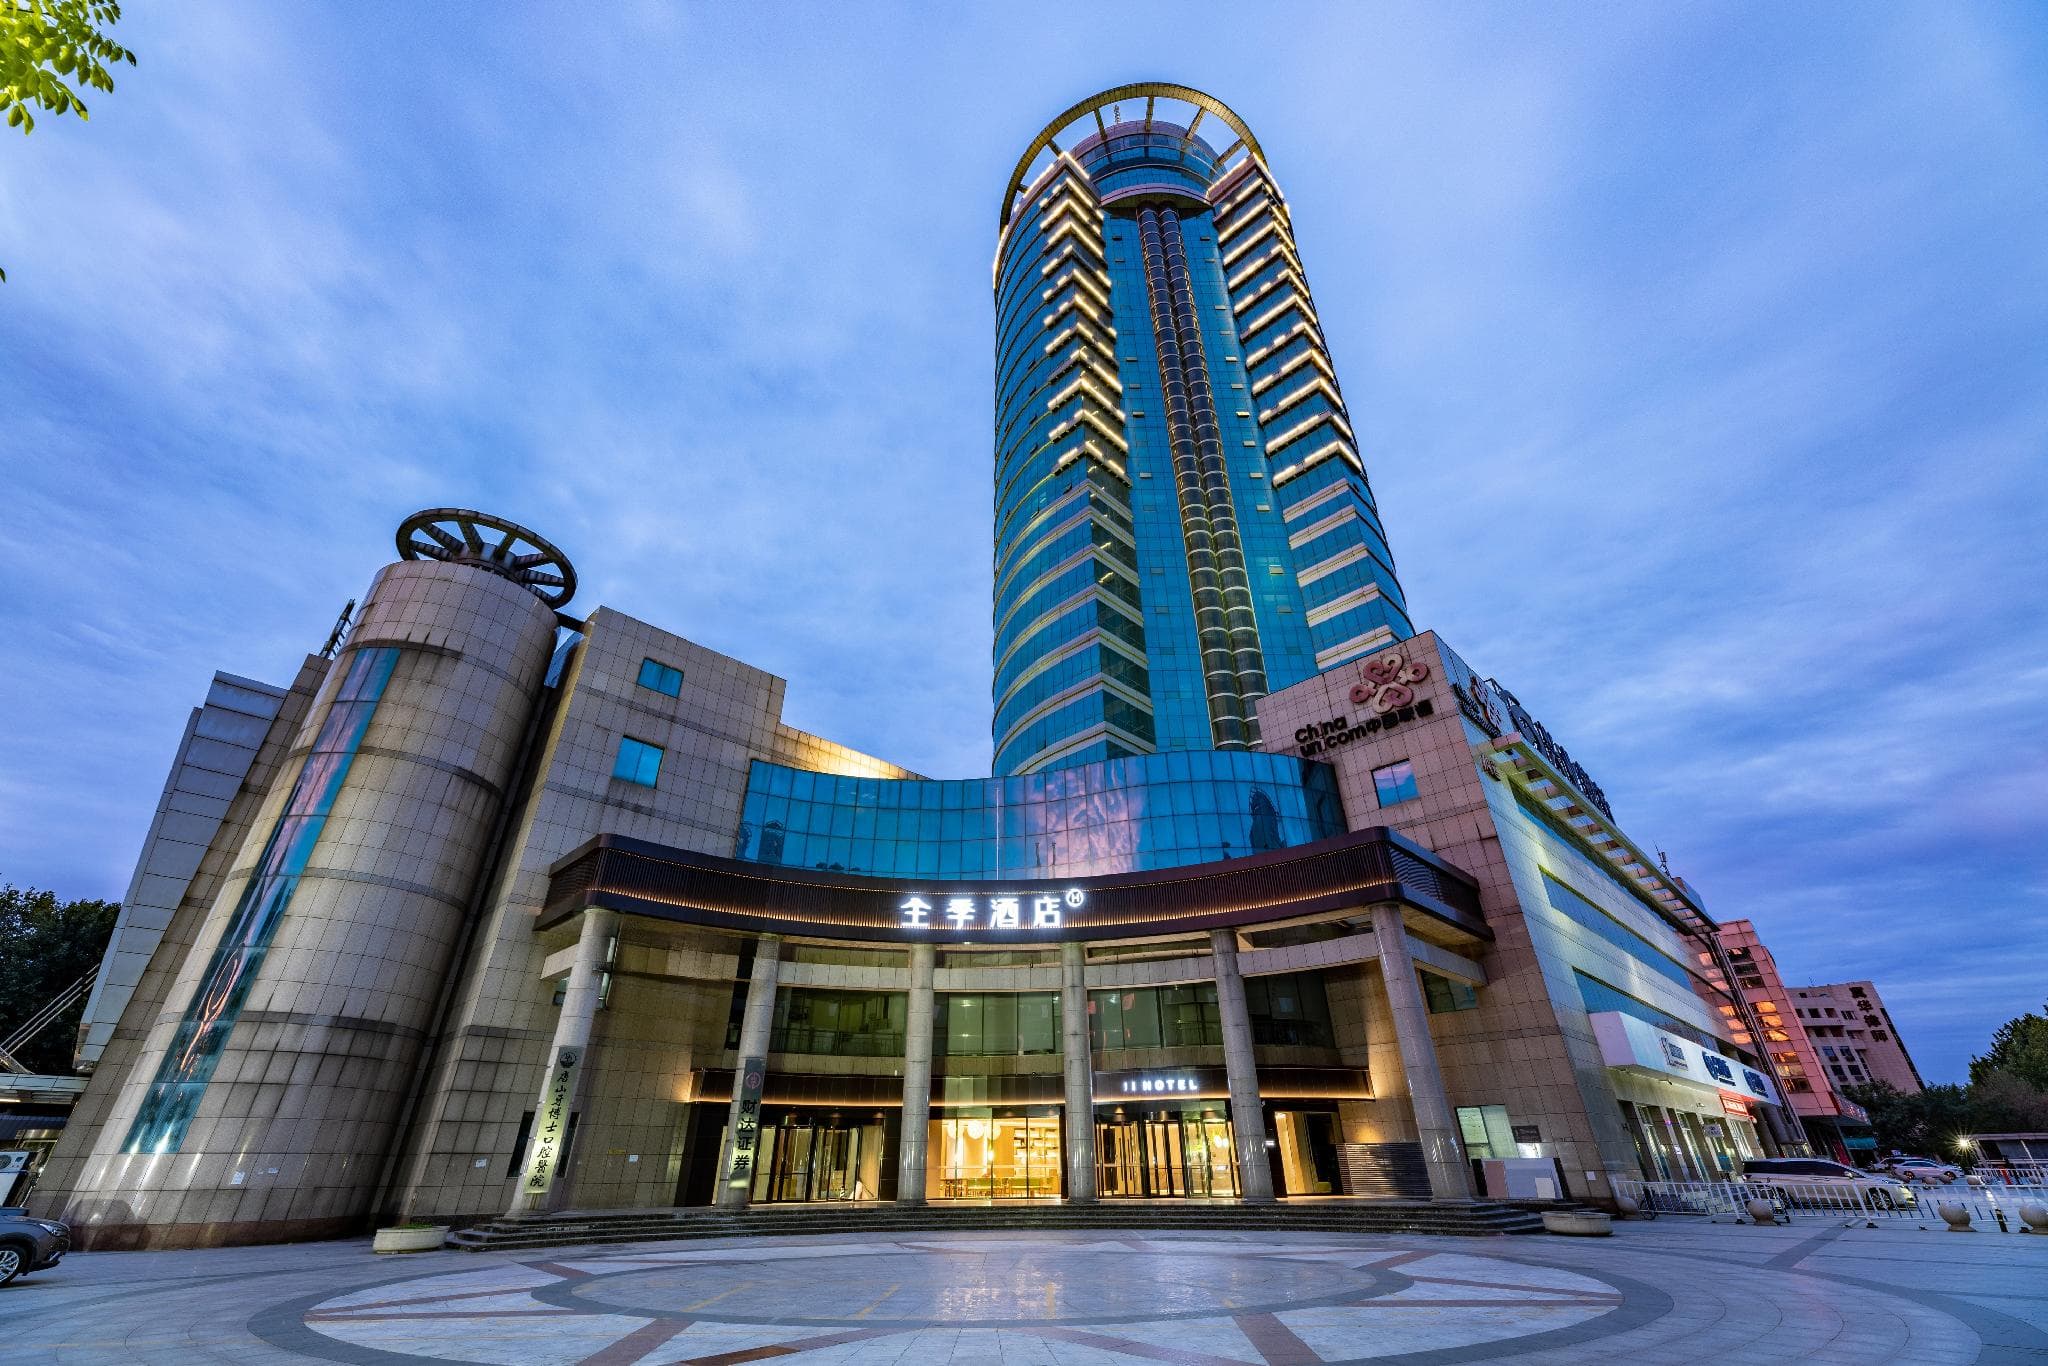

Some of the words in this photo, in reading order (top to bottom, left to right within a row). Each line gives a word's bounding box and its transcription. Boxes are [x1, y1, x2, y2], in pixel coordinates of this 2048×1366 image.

[1294, 715, 1348, 743] china
[1300, 725, 1367, 758] unicom
[900, 896, 1061, 929] 全季酒店
[1142, 1079, 1198, 1091] HOTEL
[733, 1099, 758, 1170] 财达证券
